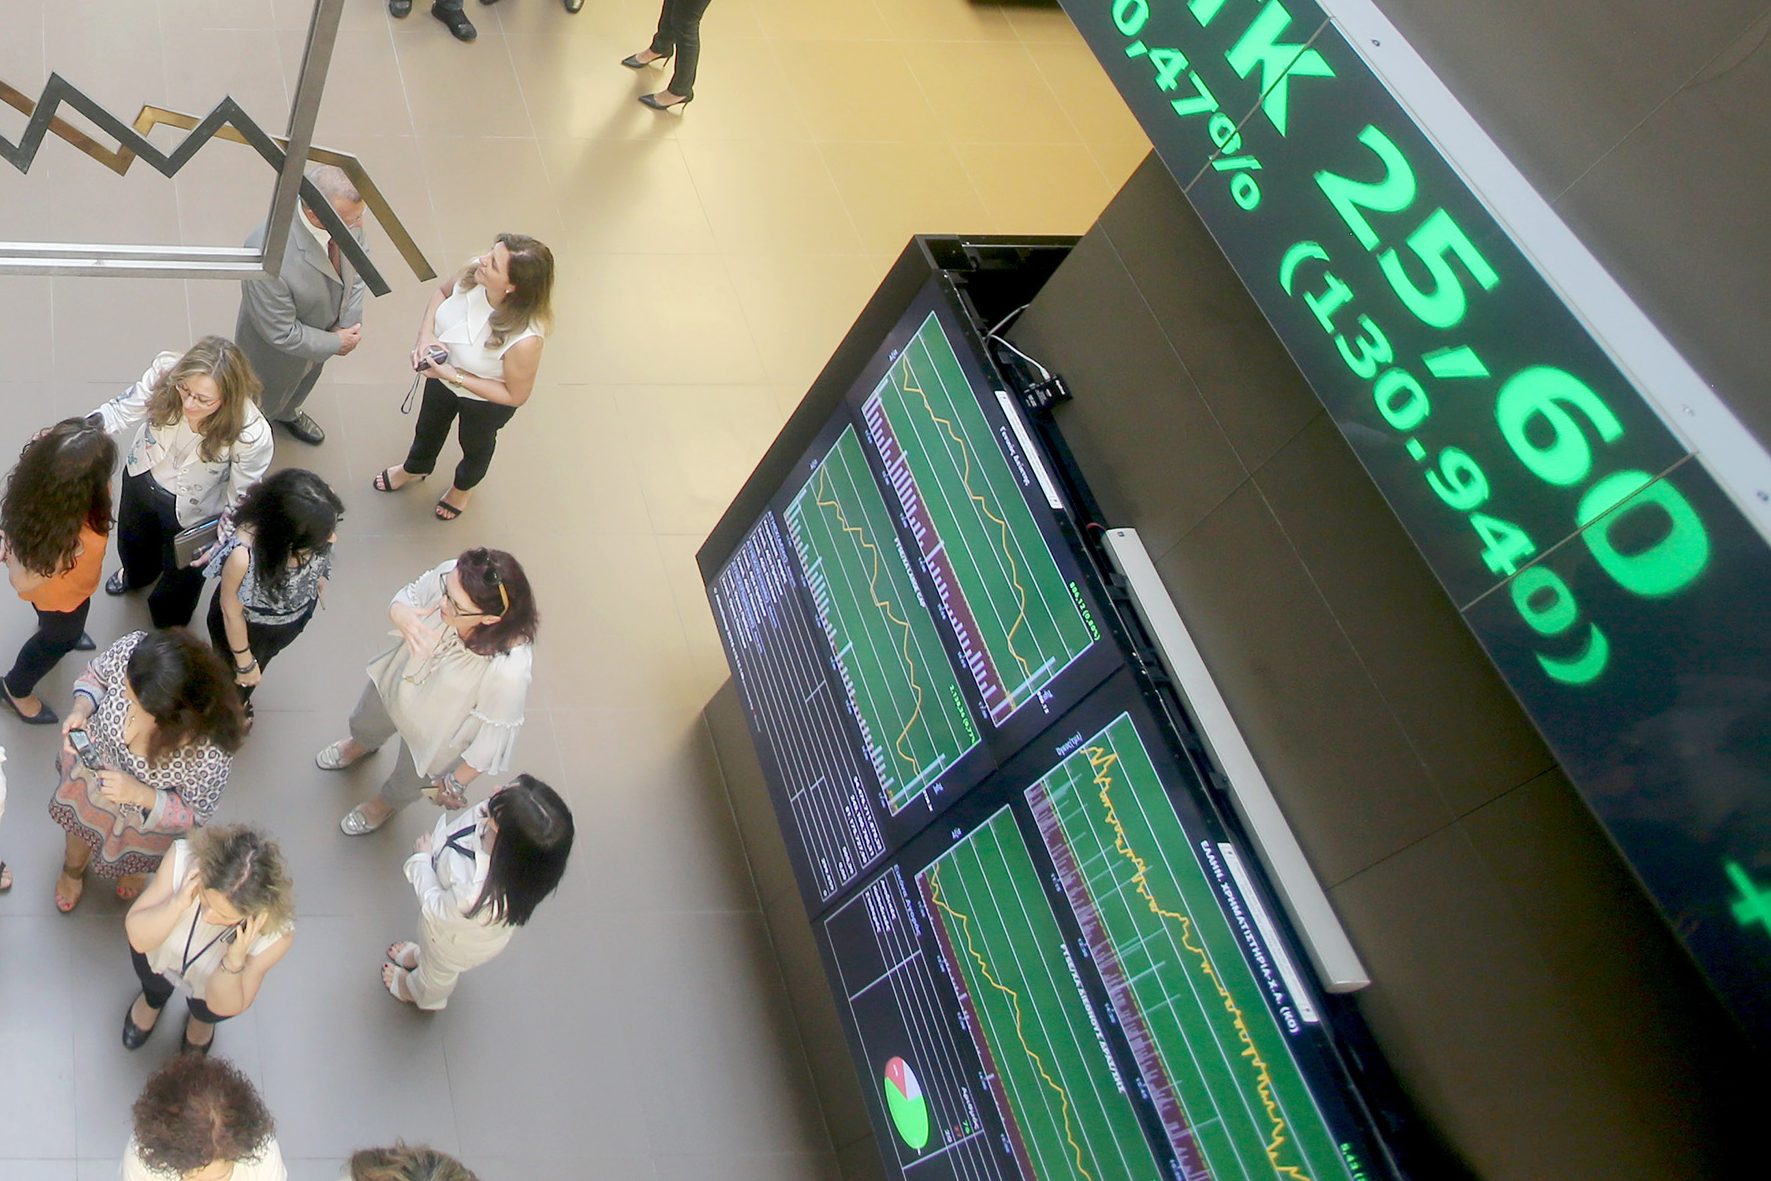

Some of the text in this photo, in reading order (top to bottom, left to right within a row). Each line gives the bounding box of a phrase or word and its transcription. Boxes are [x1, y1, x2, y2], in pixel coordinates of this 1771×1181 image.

[998, 424, 1031, 487] Γενικός Δείκτης
[1278, 239, 1611, 686] (130.940)
[1312, 123, 1712, 597] 25,60
[1068, 580, 1086, 611] 806,12
